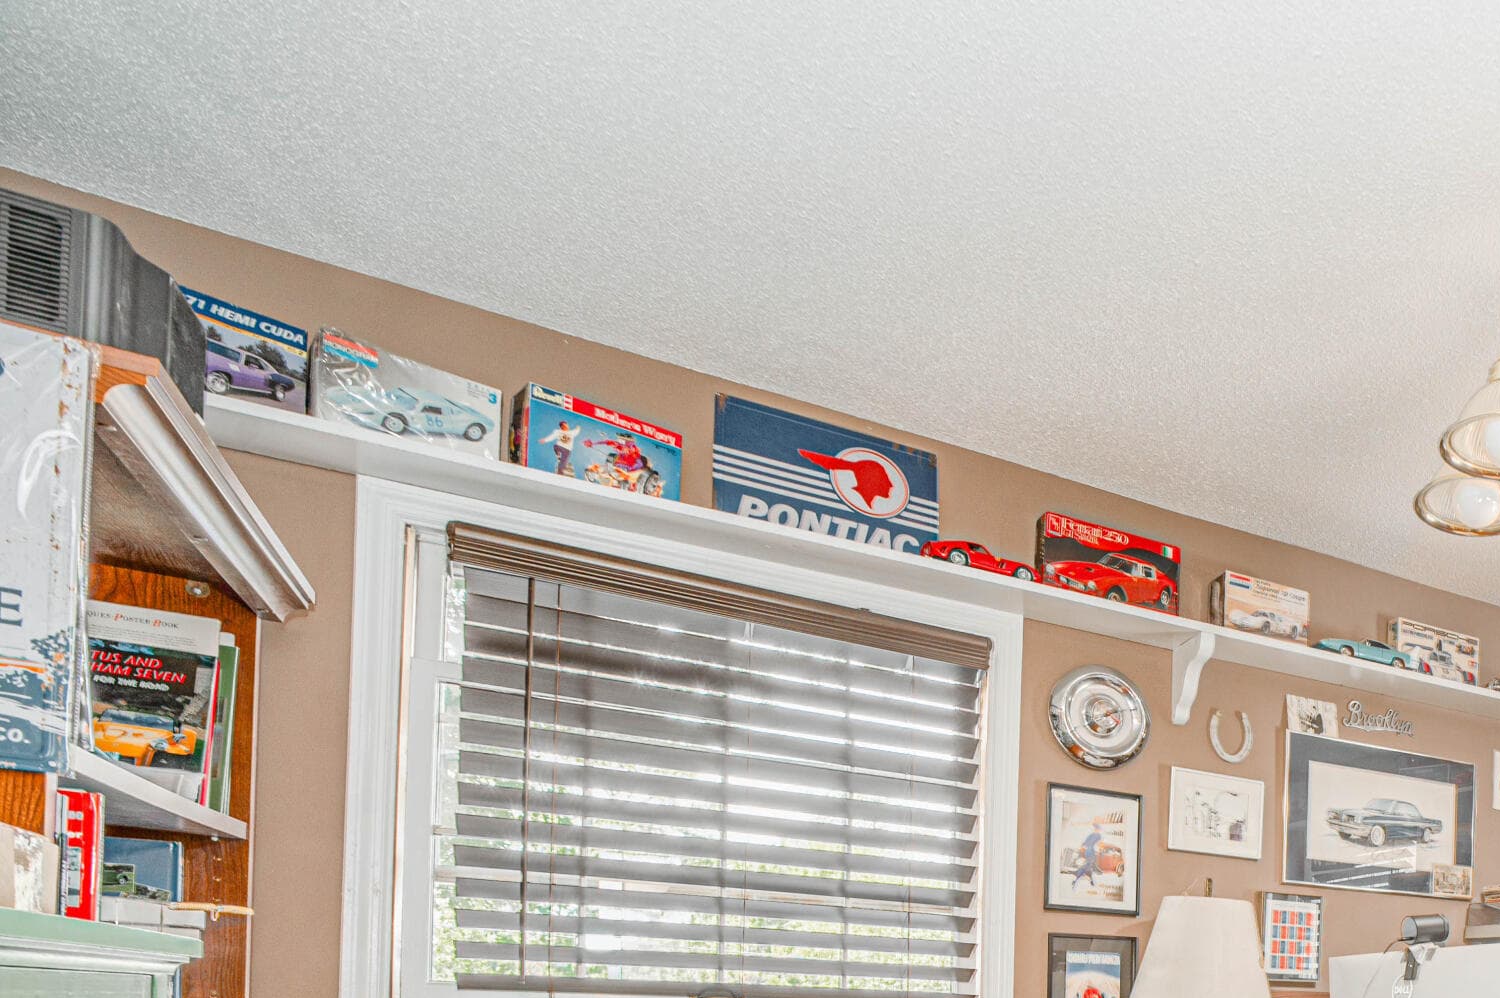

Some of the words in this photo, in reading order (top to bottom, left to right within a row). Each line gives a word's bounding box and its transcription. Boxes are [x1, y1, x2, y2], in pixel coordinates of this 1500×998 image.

[210, 304, 257, 328] HEMI
[259, 322, 304, 346] CUDA
[489, 394, 497, 405] 3
[737, 494, 919, 555] PONTIAC
[1102, 528, 1129, 545] 250
[124, 655, 163, 670] AND
[133, 667, 187, 684] SEVEN
[1343, 700, 1414, 737] Brooklyn
